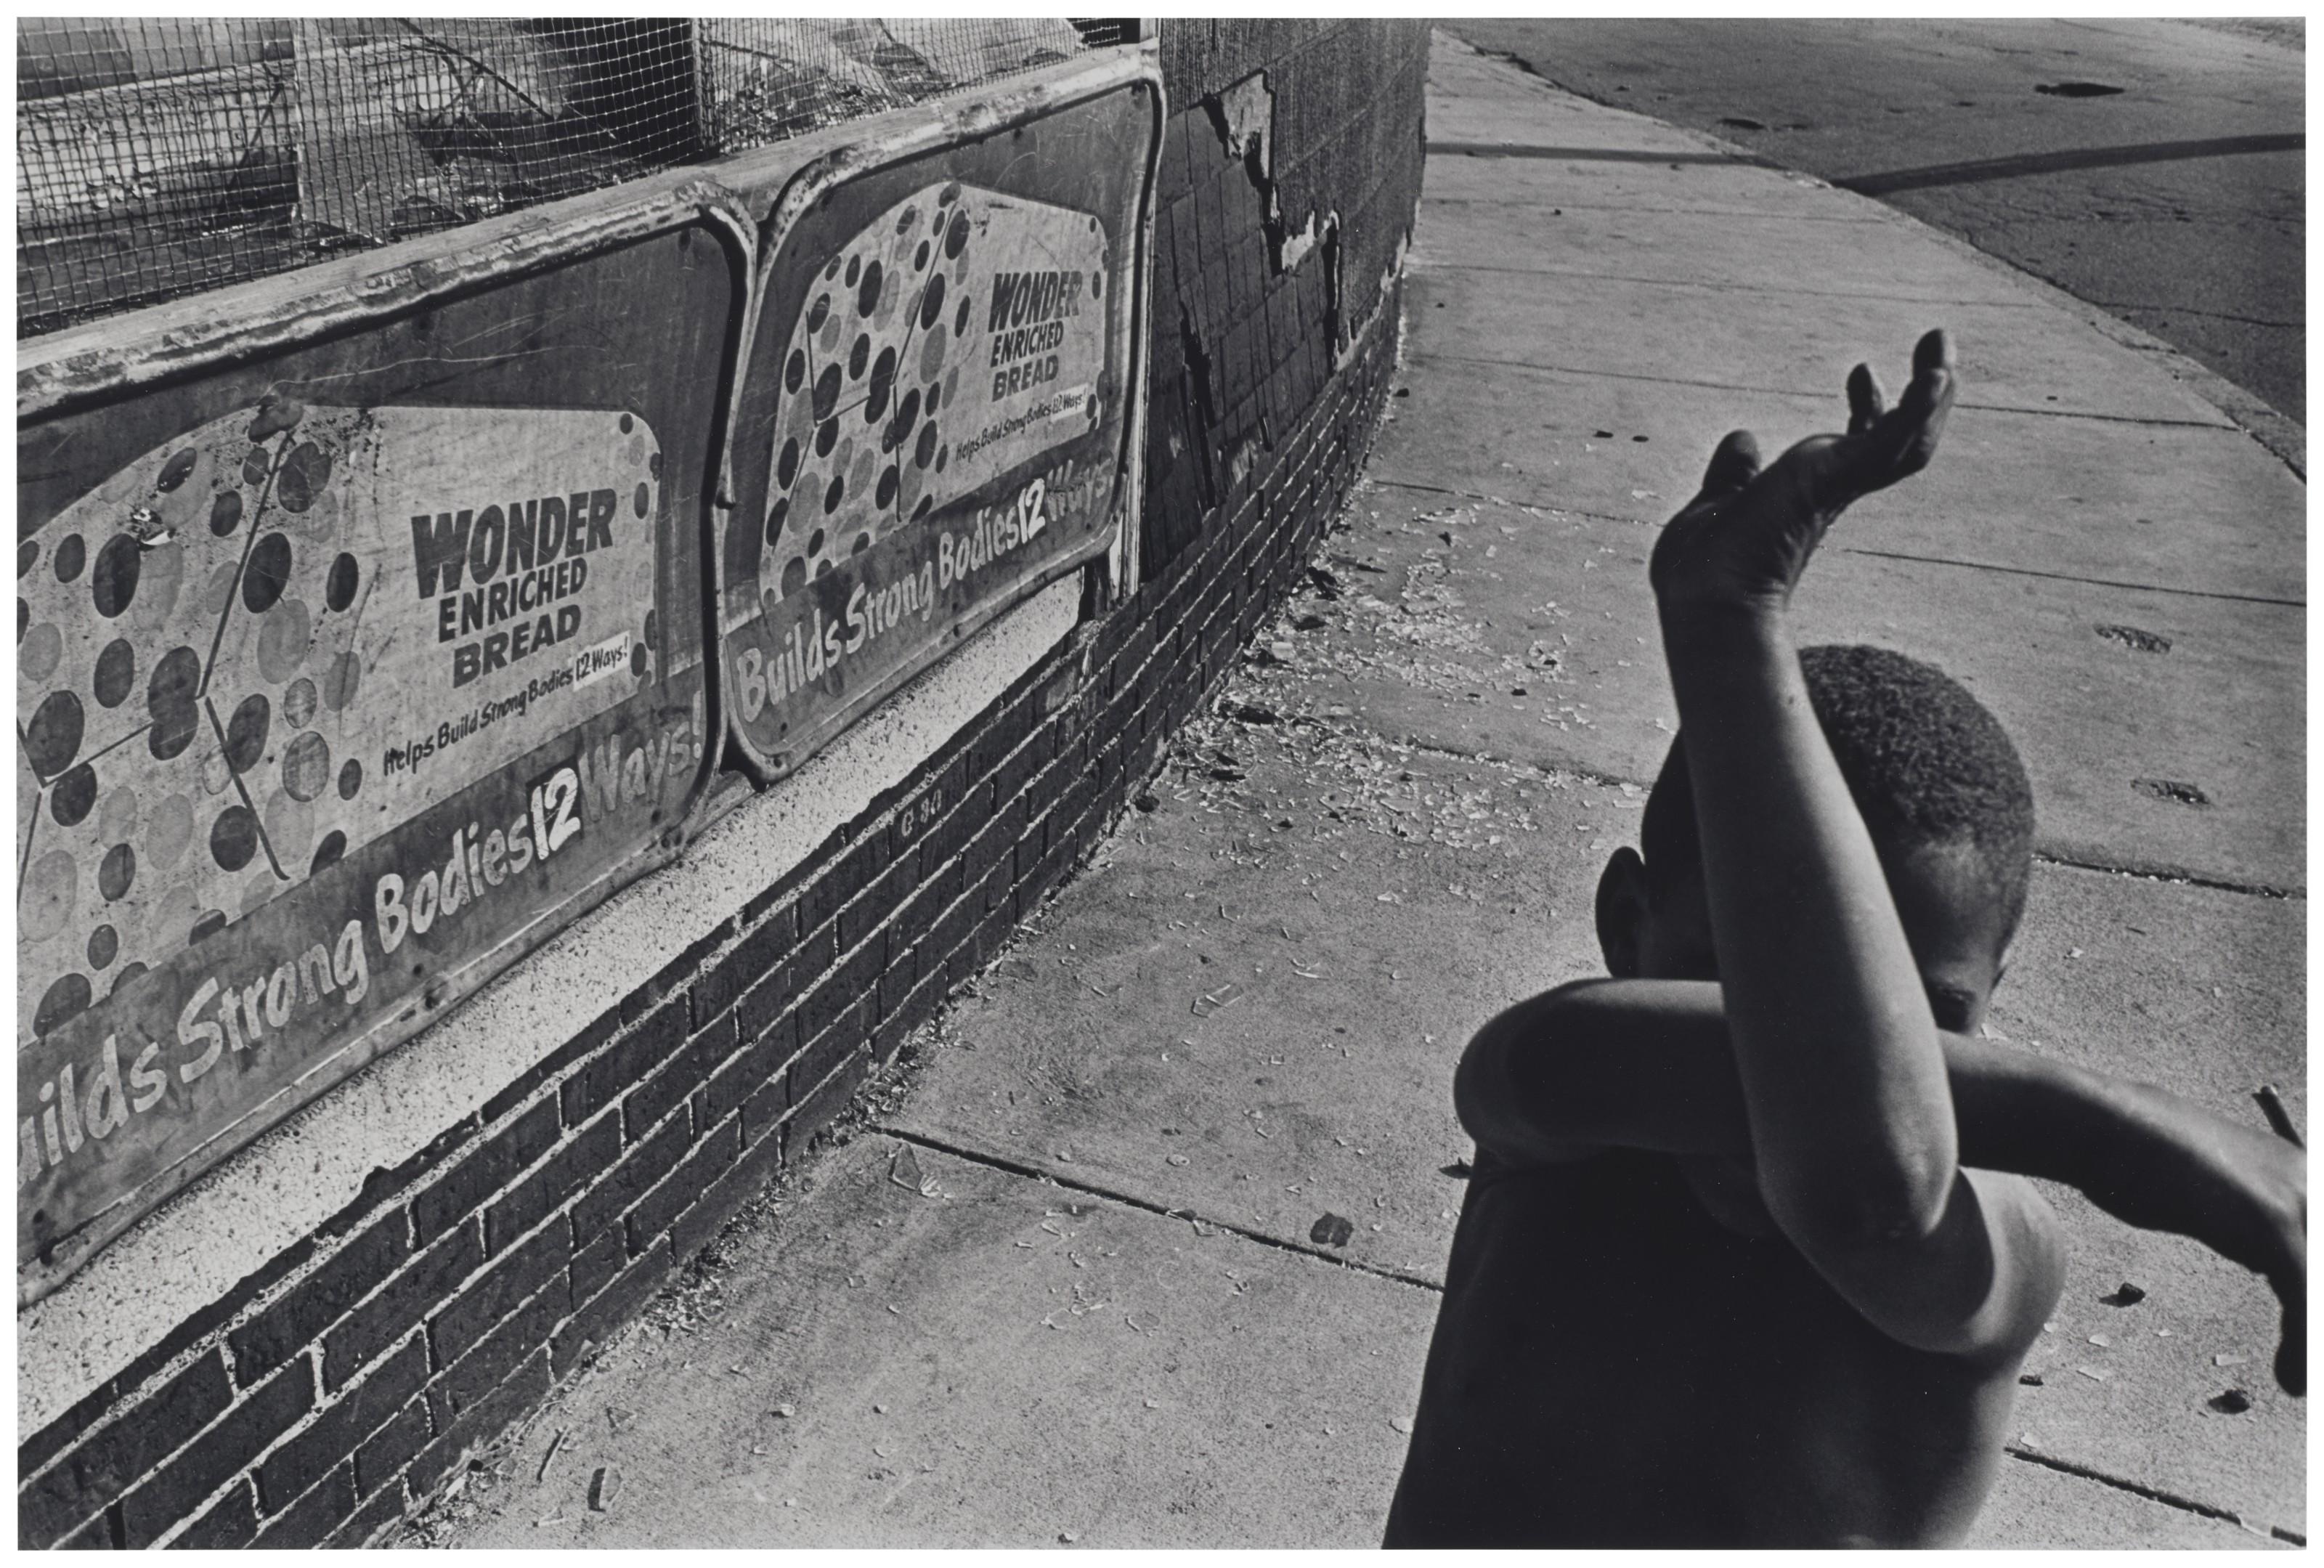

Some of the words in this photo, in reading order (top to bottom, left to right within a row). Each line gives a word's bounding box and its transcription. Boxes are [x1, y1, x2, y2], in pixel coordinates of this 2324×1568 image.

[988, 271, 1083, 333] WONDER
[991, 320, 1064, 368] ENRICHED
[992, 355, 1059, 402] BREAD
[956, 437, 980, 463] Helps
[980, 421, 1003, 447] Build
[1002, 415, 1027, 438] Strong
[1027, 402, 1052, 425] Bodies
[1063, 388, 1087, 411] Ways!
[410, 488, 617, 600] WONDER
[439, 557, 588, 643] ENRICHED
[736, 608, 842, 723] Builds
[846, 561, 934, 654] Strong
[938, 506, 1019, 591] Bodies
[1017, 477, 1046, 545] 12
[452, 604, 582, 688] BREAD
[383, 739, 435, 776] Helps
[437, 709, 480, 750] Build
[480, 690, 528, 729] Strong
[528, 670, 574, 704] Bodies
[575, 659, 592, 682] 12
[591, 635, 629, 673] Ways!
[17, 1033, 168, 1192] uilds
[177, 919, 370, 1084] Strong
[375, 822, 536, 955] Bodies
[530, 767, 581, 861] 12
[578, 691, 702, 821] Ways!
